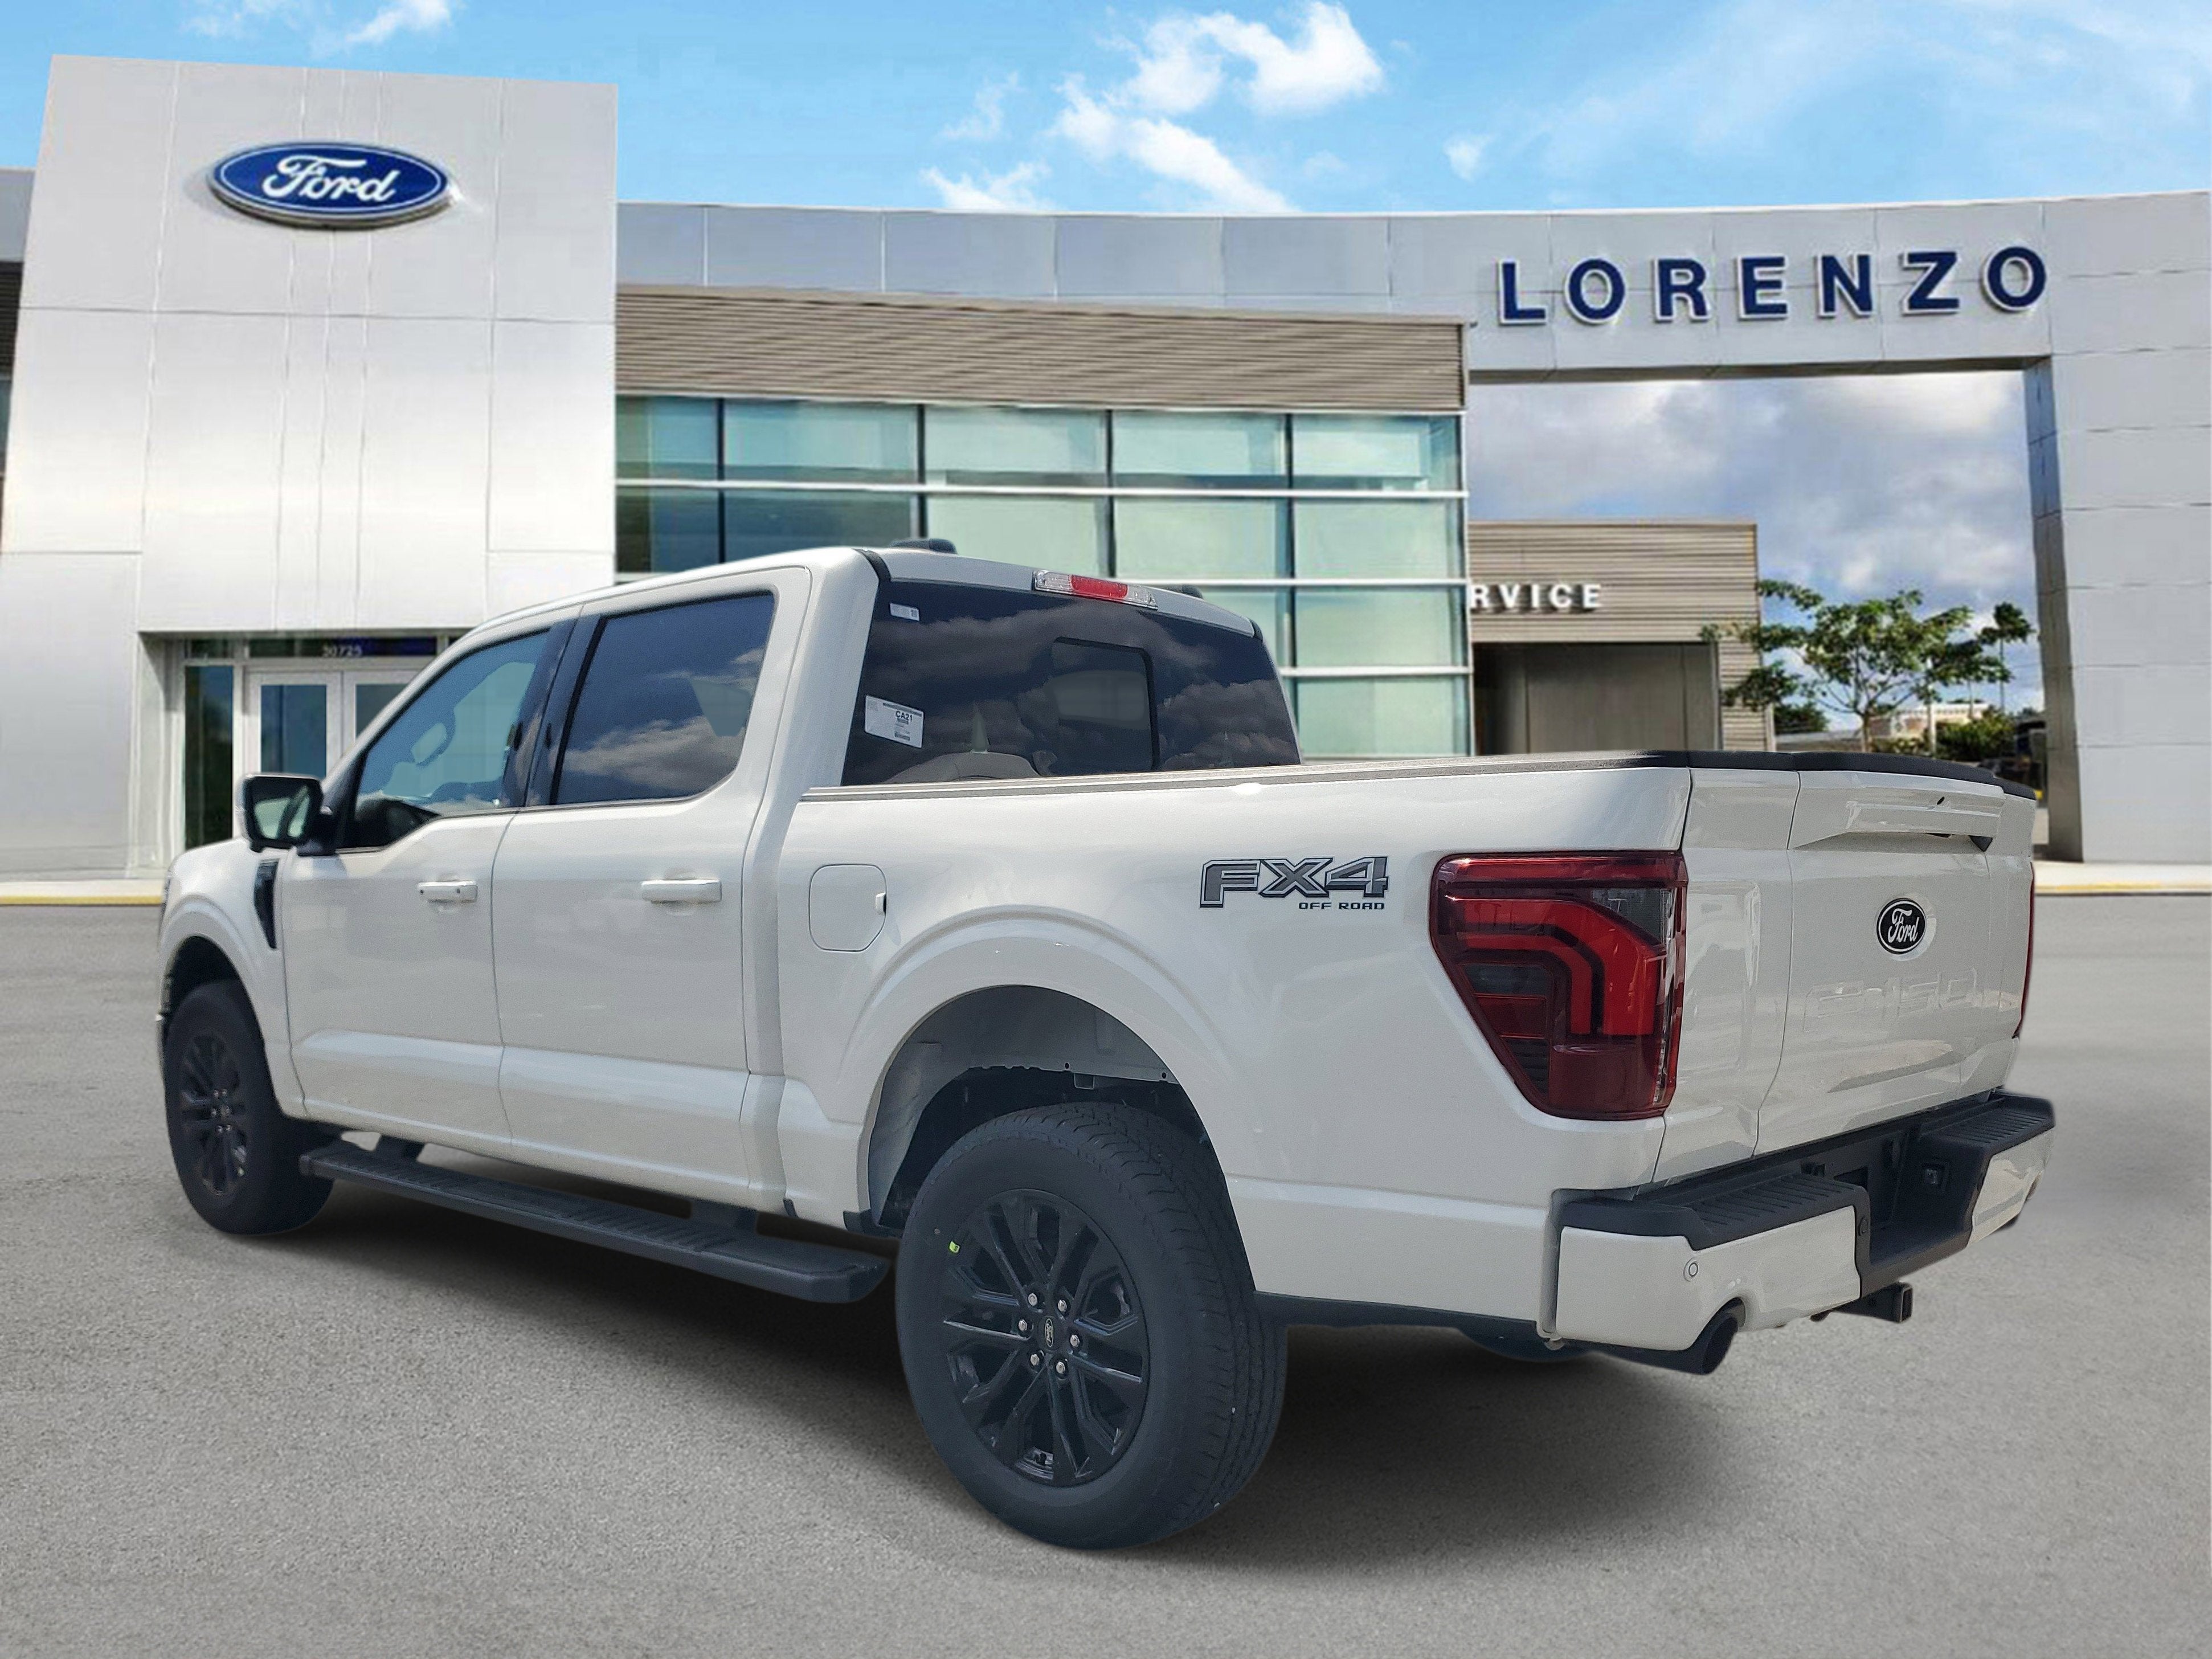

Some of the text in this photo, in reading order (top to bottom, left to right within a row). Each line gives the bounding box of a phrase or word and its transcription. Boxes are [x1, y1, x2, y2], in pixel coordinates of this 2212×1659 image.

[262, 154, 400, 202] Ford
[1497, 247, 2047, 326] LORENZO
[1199, 856, 1389, 908] FX4
[1298, 902, 1385, 910] OFF ROAD
[1887, 908, 1920, 943] Ford
